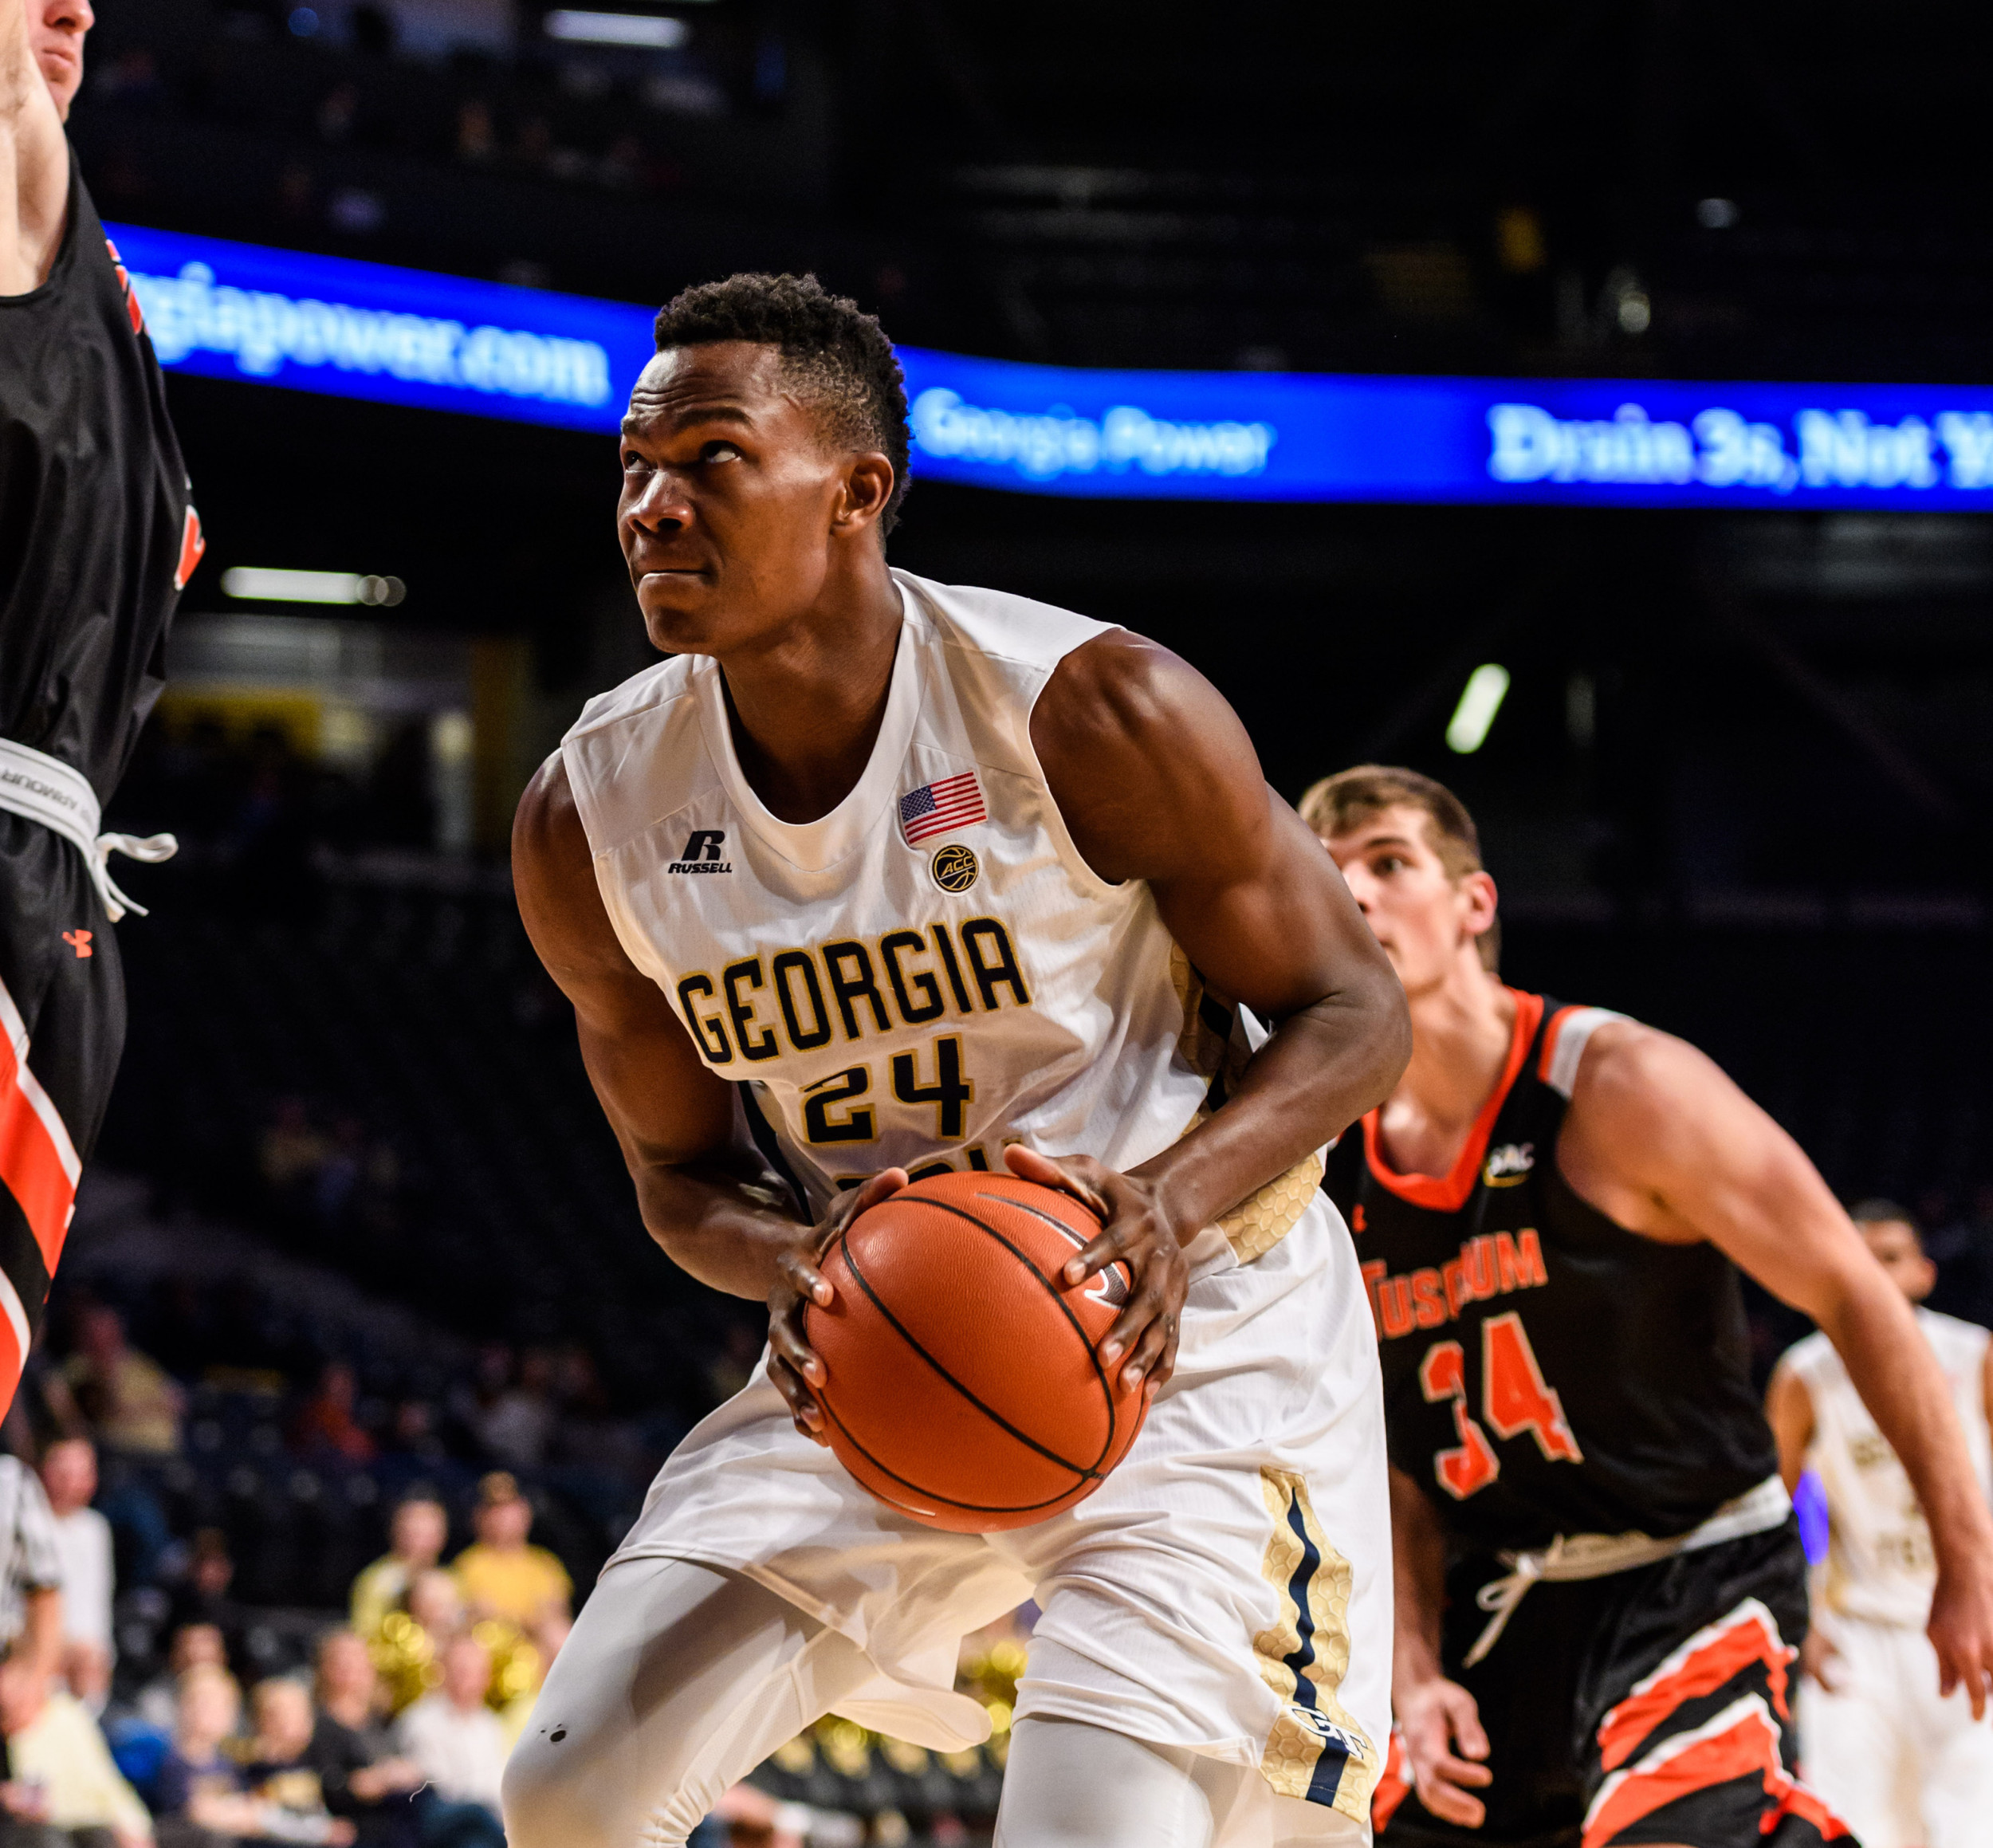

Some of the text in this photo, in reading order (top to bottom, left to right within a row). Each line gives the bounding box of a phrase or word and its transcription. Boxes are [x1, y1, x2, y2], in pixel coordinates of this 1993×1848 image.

[1103, 406, 1276, 475] Power
[1488, 403, 1692, 484] Drain
[1795, 408, 1937, 488] Not
[667, 862, 733, 875] RUSSELL
[941, 854, 974, 878] ACC
[677, 915, 1033, 1066] GEORGIA
[800, 1032, 974, 1144] 24
[1419, 1311, 1584, 1501] 34
